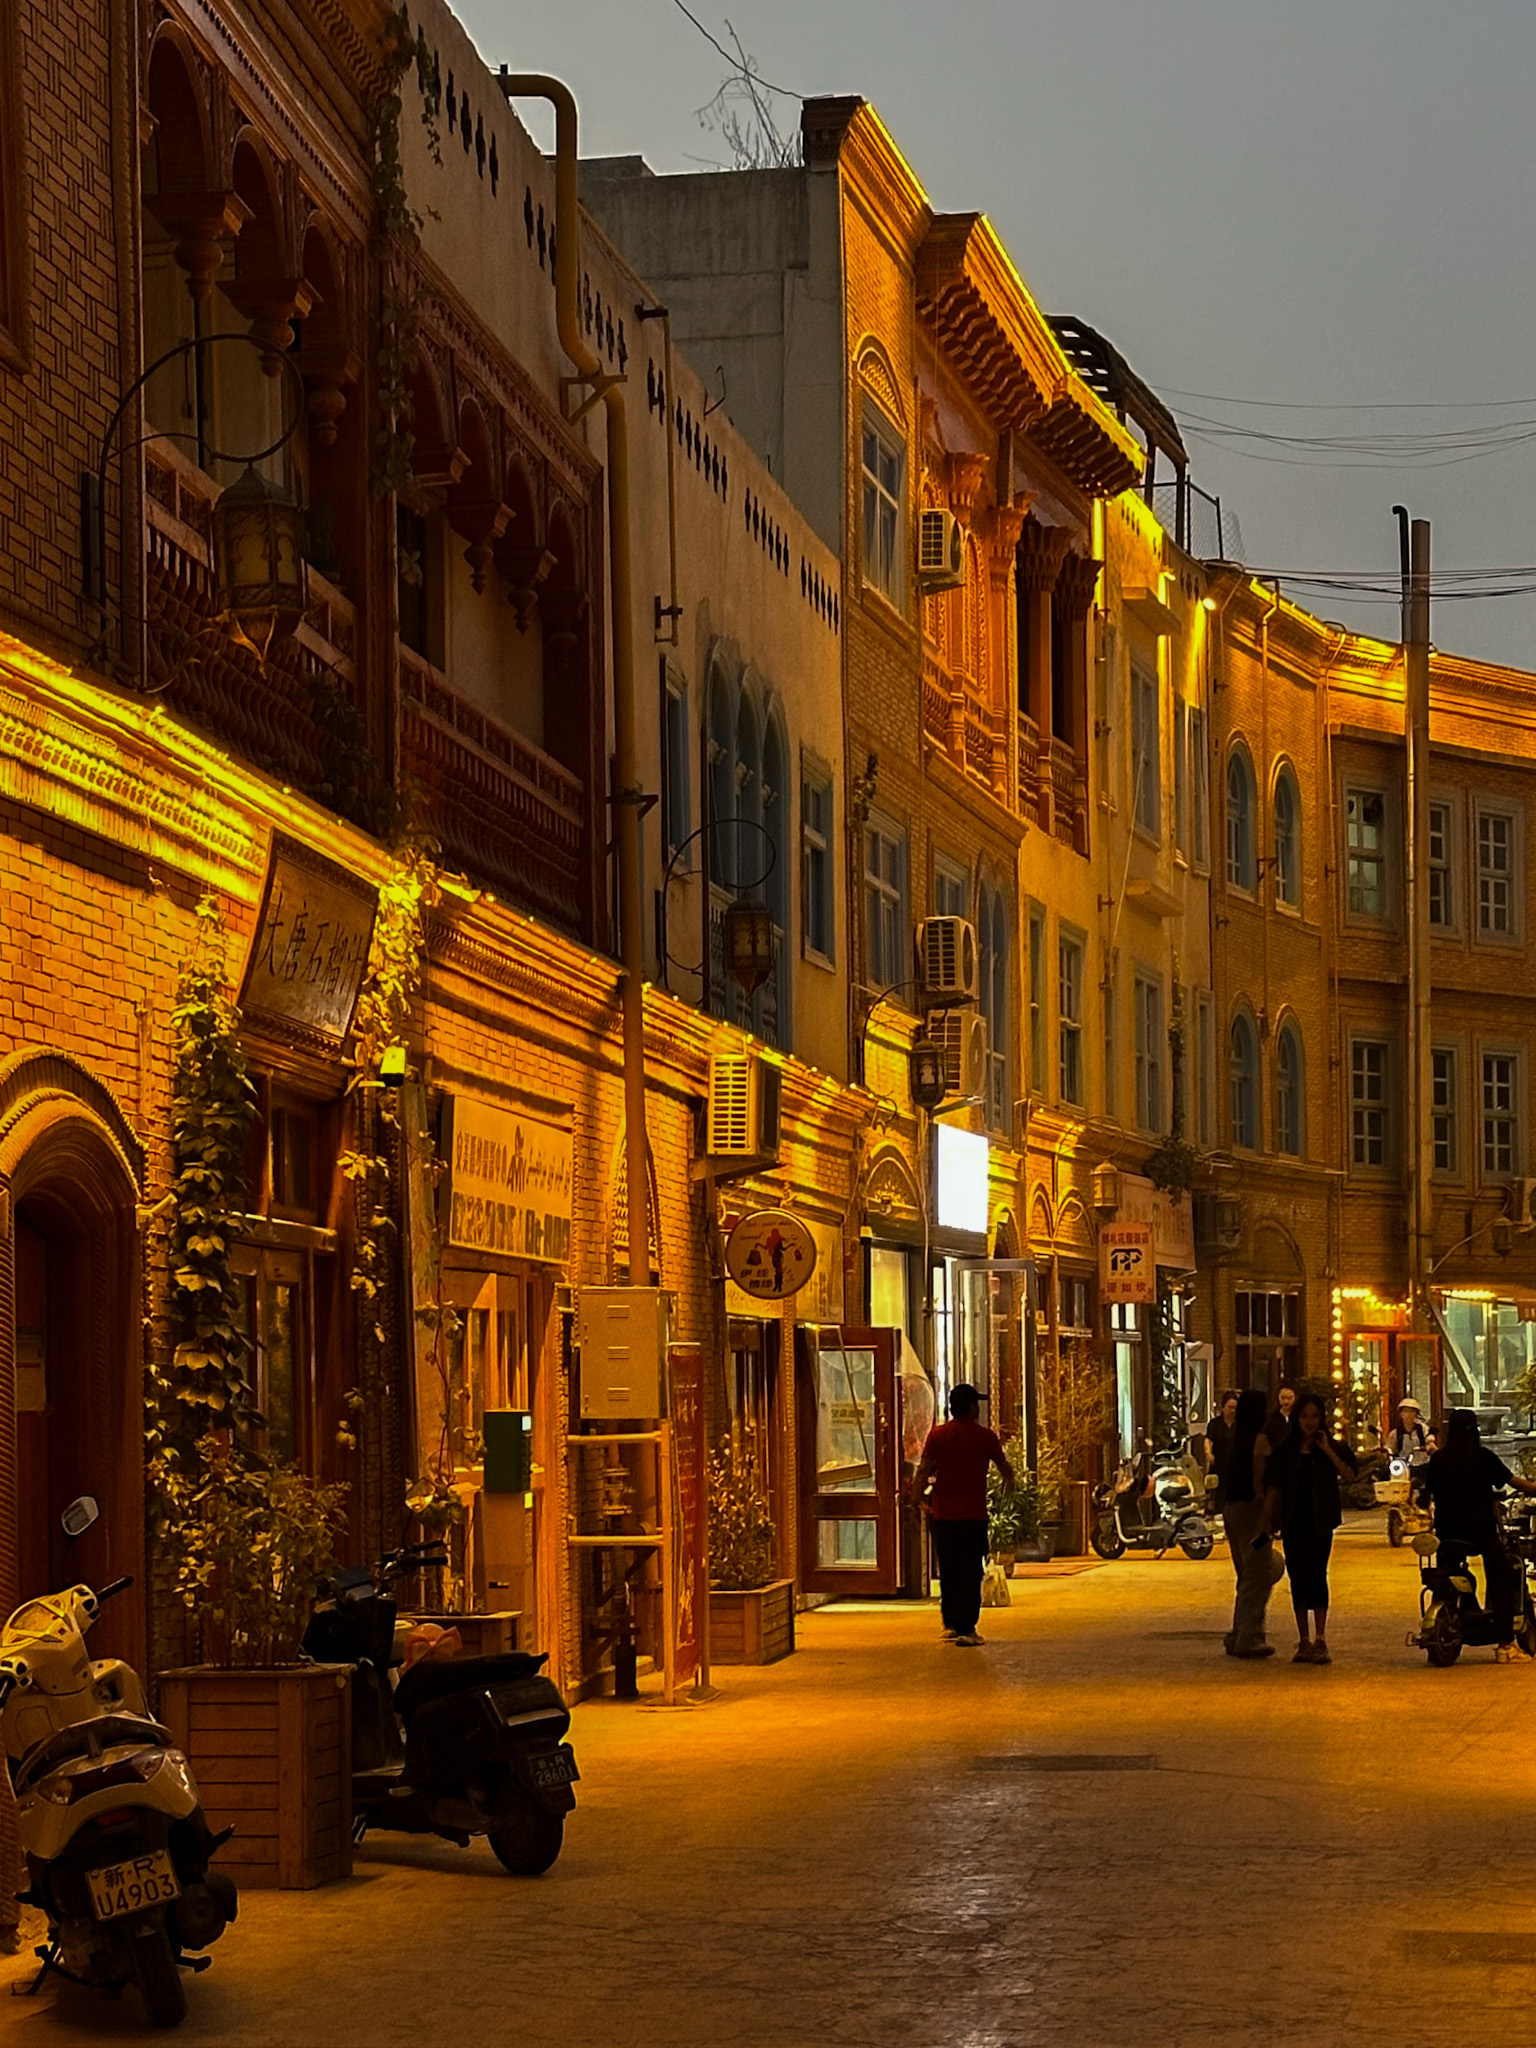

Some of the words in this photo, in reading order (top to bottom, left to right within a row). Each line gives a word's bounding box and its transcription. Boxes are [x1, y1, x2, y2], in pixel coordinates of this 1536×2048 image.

[257, 890, 364, 998] 大唐石榴汁
[535, 1765, 574, 1785] 28601
[103, 1857, 157, 1889] 新·R
[97, 1874, 175, 1917] U4903
